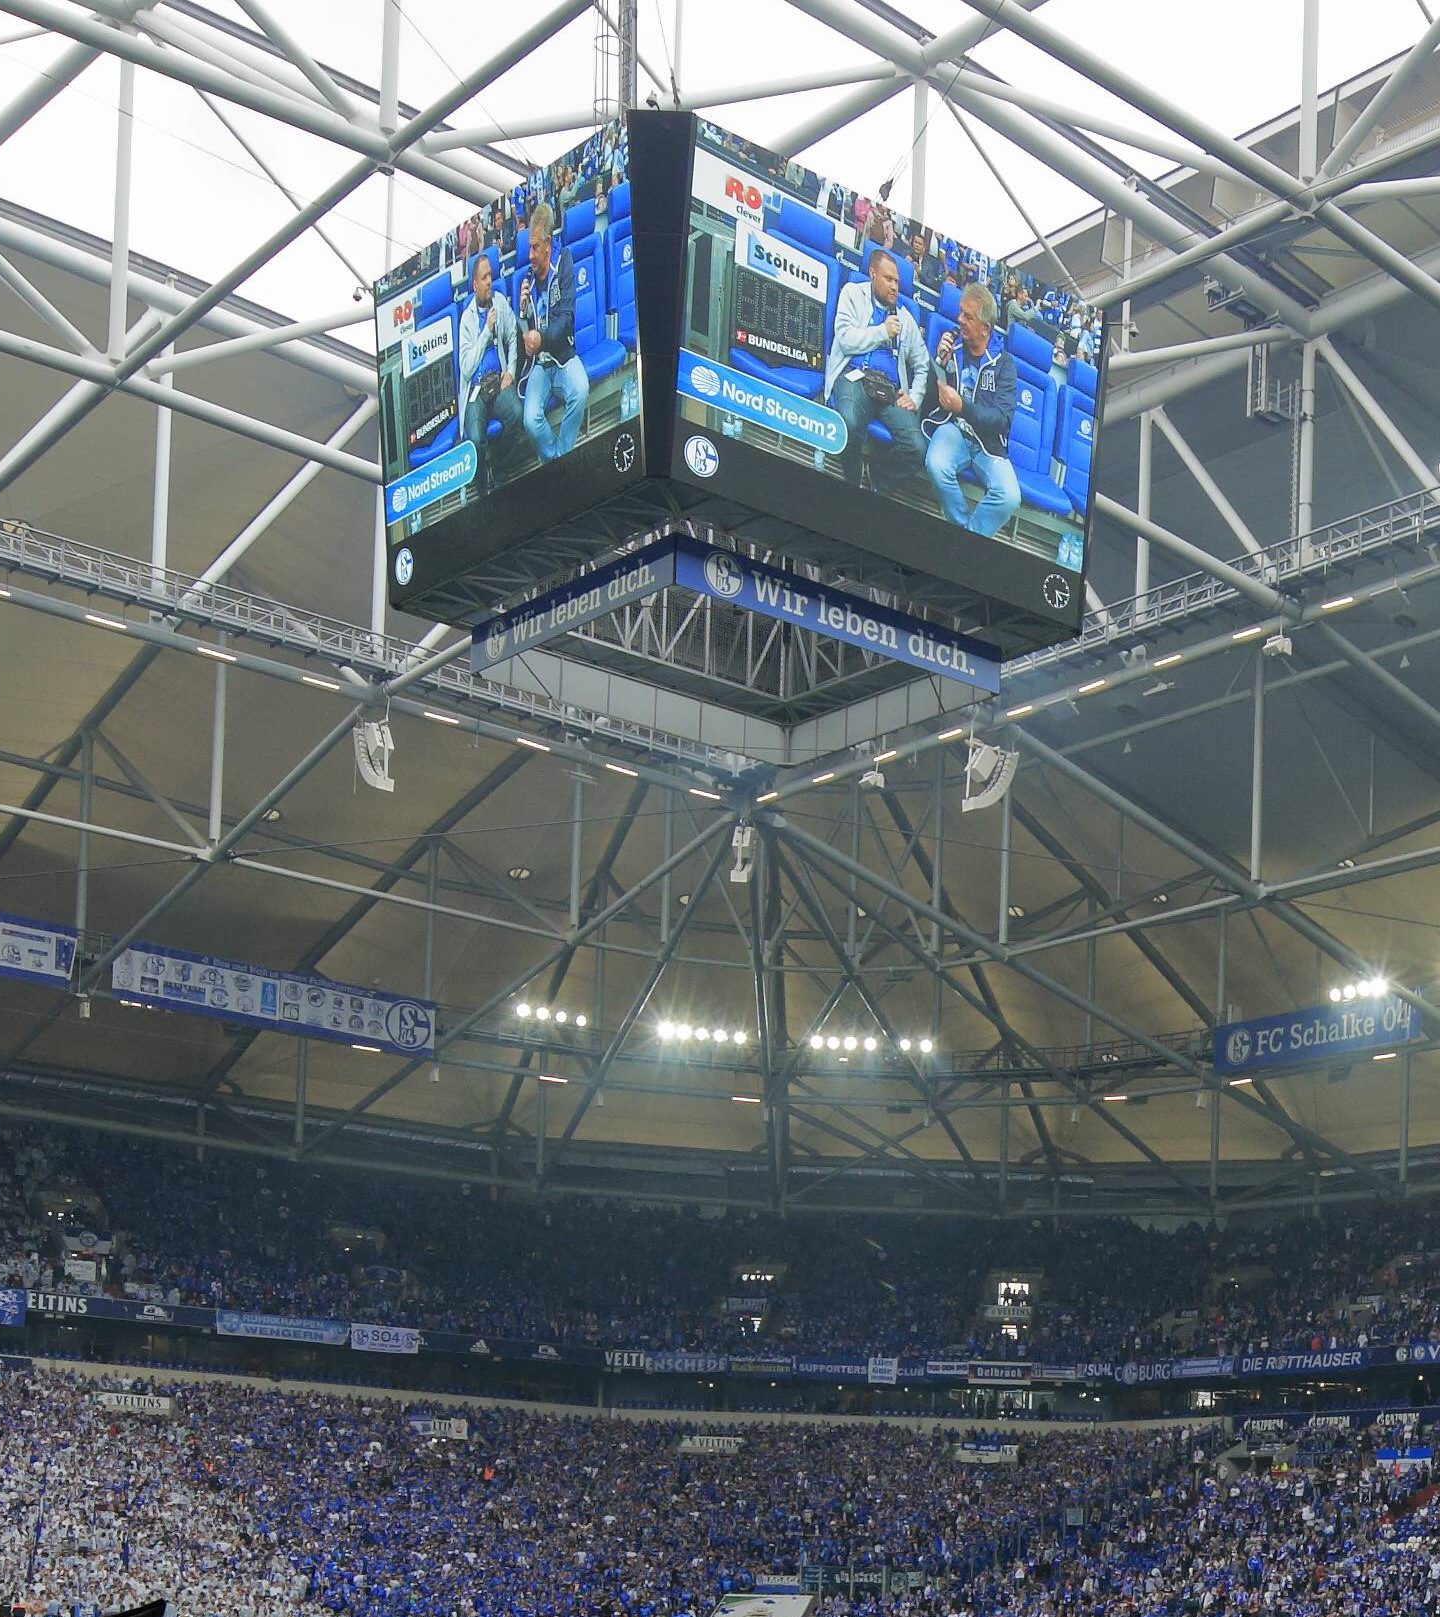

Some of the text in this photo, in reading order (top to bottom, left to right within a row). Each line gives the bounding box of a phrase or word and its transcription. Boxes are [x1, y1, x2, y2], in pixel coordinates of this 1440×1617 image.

[754, 244, 819, 289] Stölting
[412, 333, 448, 360] Stölting
[748, 334, 808, 362] BUNDESLIGA
[722, 380, 836, 441] Nord Stream 2
[407, 454, 471, 501] Nord Stream 2
[511, 558, 655, 645] Wir leben dich.
[751, 570, 976, 676] Wir leben dich.
[1255, 1004, 1411, 1056] FC Schalke 04
[27, 1291, 87, 1314] ELTINS
[605, 1351, 644, 1367] VELTI
[646, 1356, 728, 1373] ENSCHEDE
[799, 1363, 867, 1375] SUPPORTERS
[897, 1365, 926, 1378] CLUB
[1242, 1357, 1262, 1372] DIE
[115, 1395, 161, 1408] VELTINS
